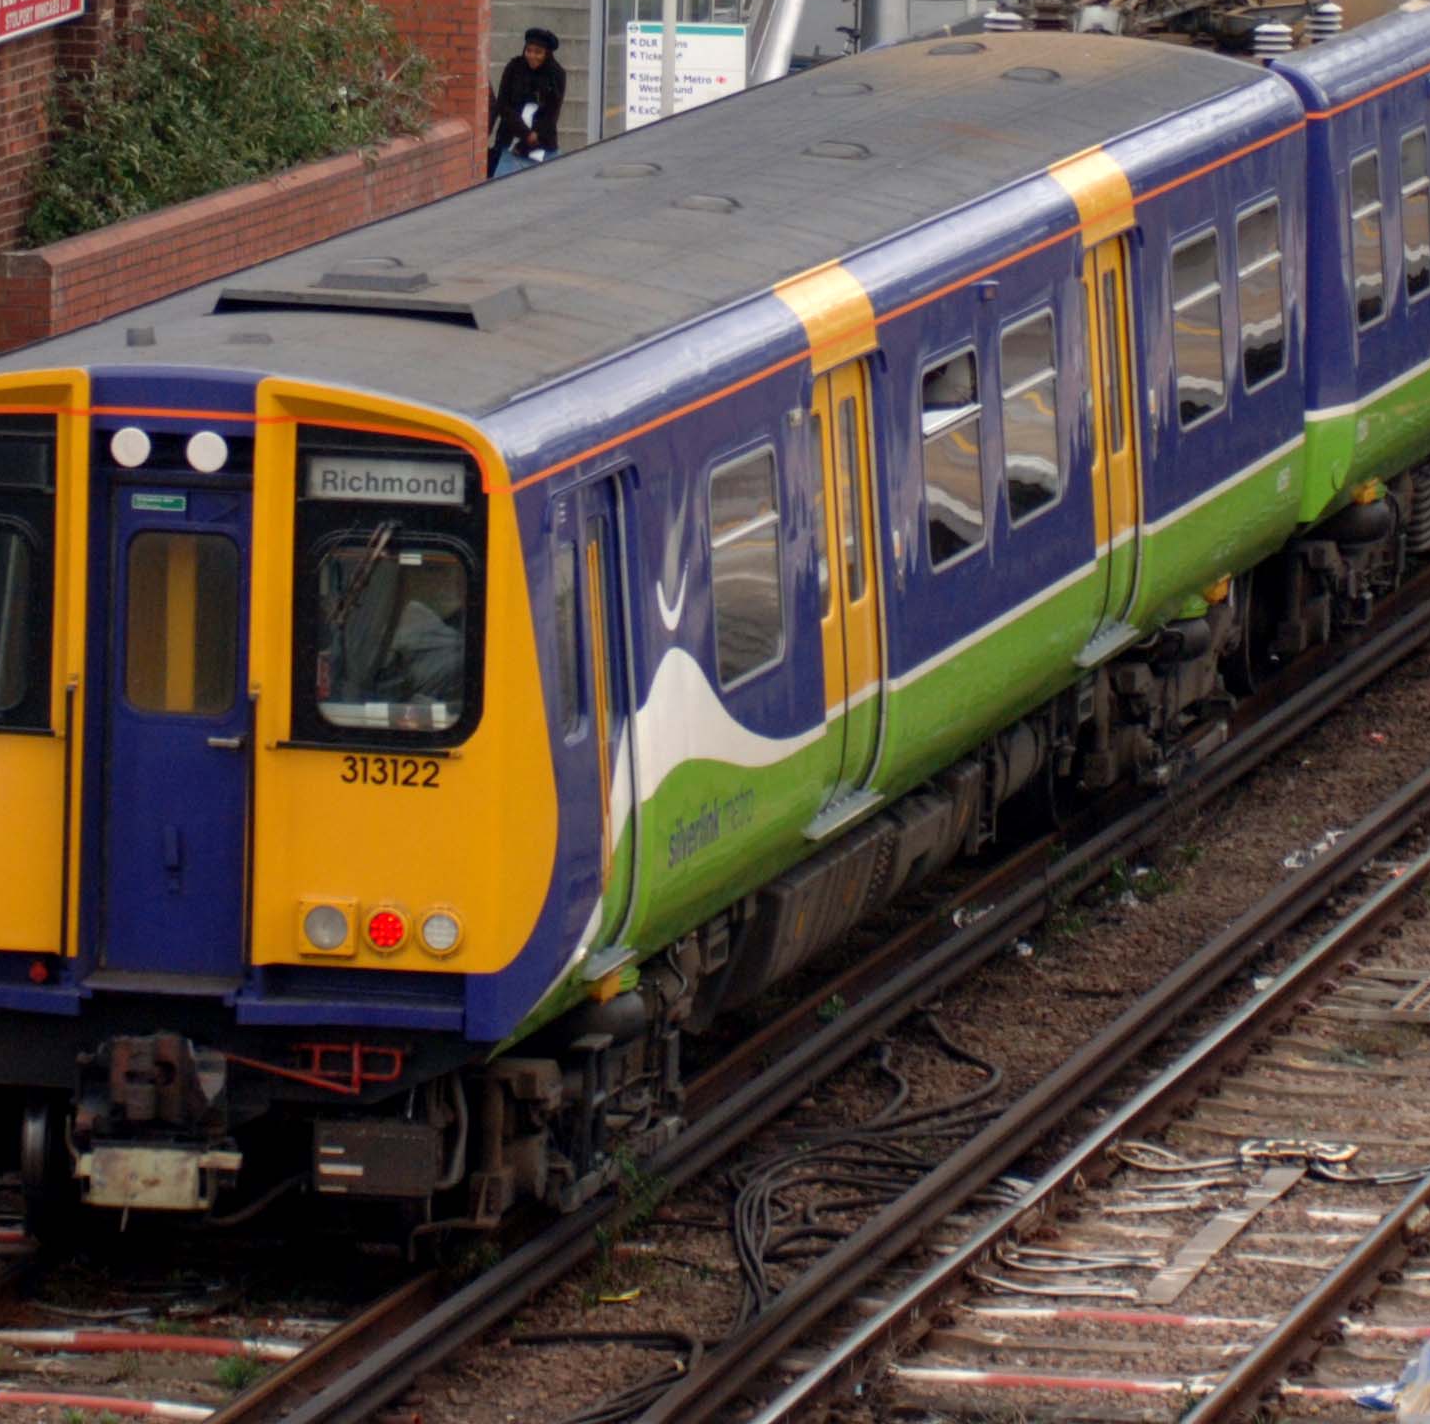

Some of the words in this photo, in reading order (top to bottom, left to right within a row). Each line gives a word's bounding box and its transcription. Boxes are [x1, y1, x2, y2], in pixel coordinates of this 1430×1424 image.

[639, 39, 658, 48] DLR
[683, 74, 713, 84] Metro
[320, 469, 457, 496] Richmond
[340, 755, 440, 788] 313122
